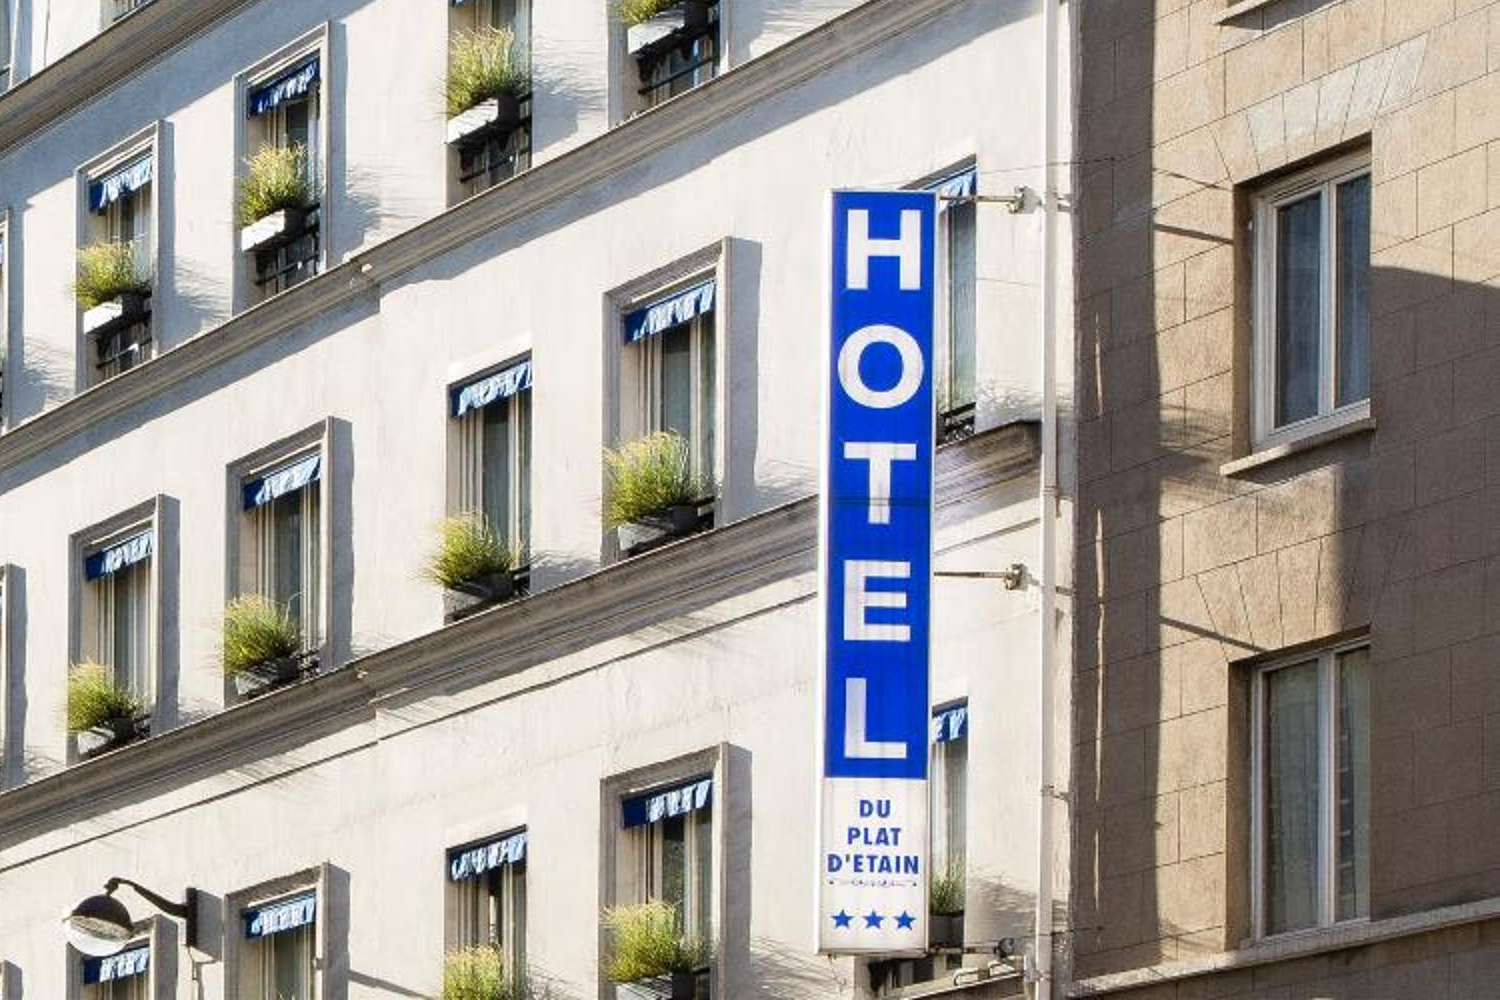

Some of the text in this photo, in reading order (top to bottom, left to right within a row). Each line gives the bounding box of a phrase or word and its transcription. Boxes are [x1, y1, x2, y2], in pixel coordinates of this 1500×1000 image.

[837, 208, 924, 759] HOTEL
[859, 799, 891, 819] DU
[847, 827, 902, 846] PLAT
[827, 854, 919, 874] D'ETAIN
